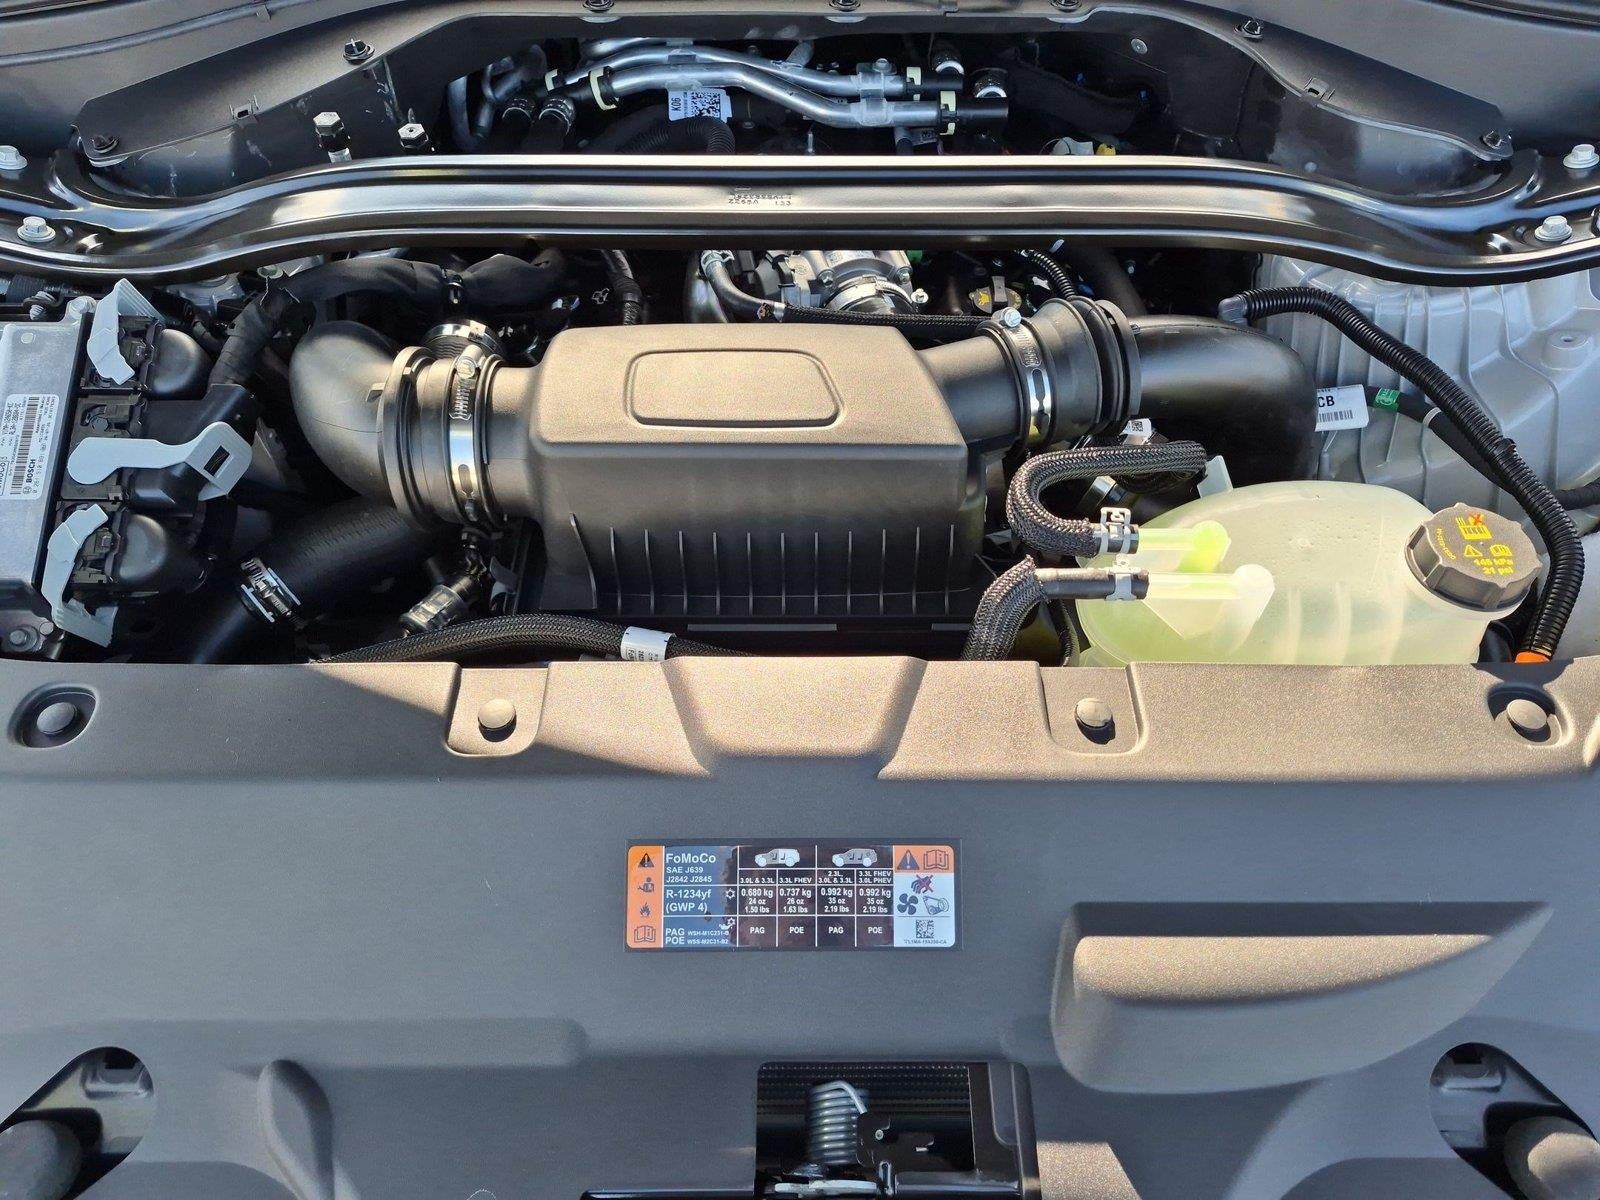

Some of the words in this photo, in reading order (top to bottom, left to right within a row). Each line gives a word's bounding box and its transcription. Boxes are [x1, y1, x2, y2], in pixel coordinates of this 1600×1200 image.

[671, 97, 681, 111] K06
[26, 459, 36, 483] BOSCH
[665, 853, 716, 864] FoMoCo
[666, 889, 712, 900] R-1234yf
[741, 888, 762, 896] 0.680
[763, 888, 773, 898] kg
[779, 888, 800, 896] 0.737
[801, 888, 812, 898] kg
[821, 888, 841, 896] 0.992
[843, 888, 853, 898] kg
[859, 888, 880, 896] 0.992
[881, 888, 891, 898] kg
[665, 902, 696, 914] (GWP
[698, 902, 708, 914] 4)
[665, 928, 685, 936] PAG
[749, 926, 765, 934] PAG
[789, 926, 805, 934] POE
[828, 926, 844, 934] PAG
[868, 926, 883, 934] POE
[665, 936, 685, 945] POE
